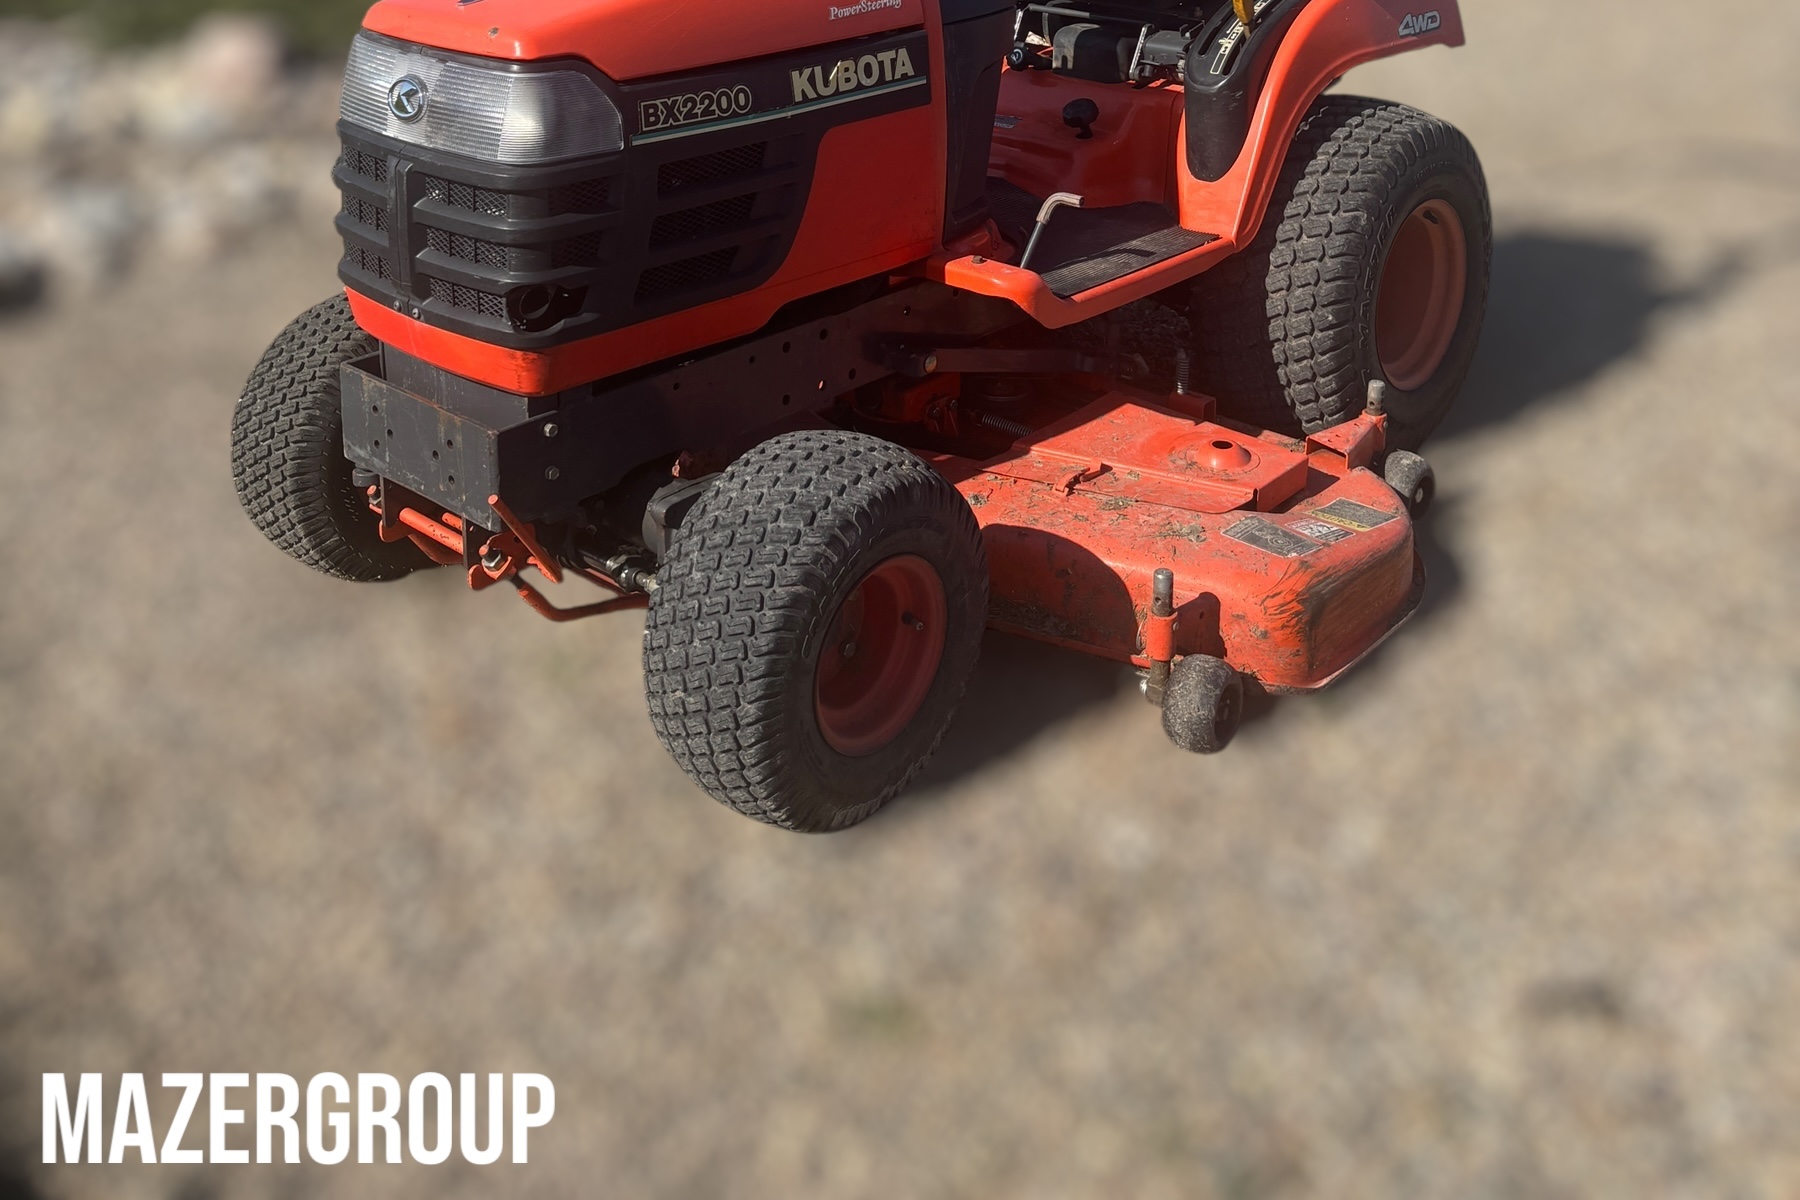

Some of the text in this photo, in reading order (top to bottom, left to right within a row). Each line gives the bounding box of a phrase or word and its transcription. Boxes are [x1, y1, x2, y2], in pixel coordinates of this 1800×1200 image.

[1398, 10, 1440, 37] 4WD
[790, 47, 915, 102] KUBOTA
[638, 84, 752, 132] BX2200
